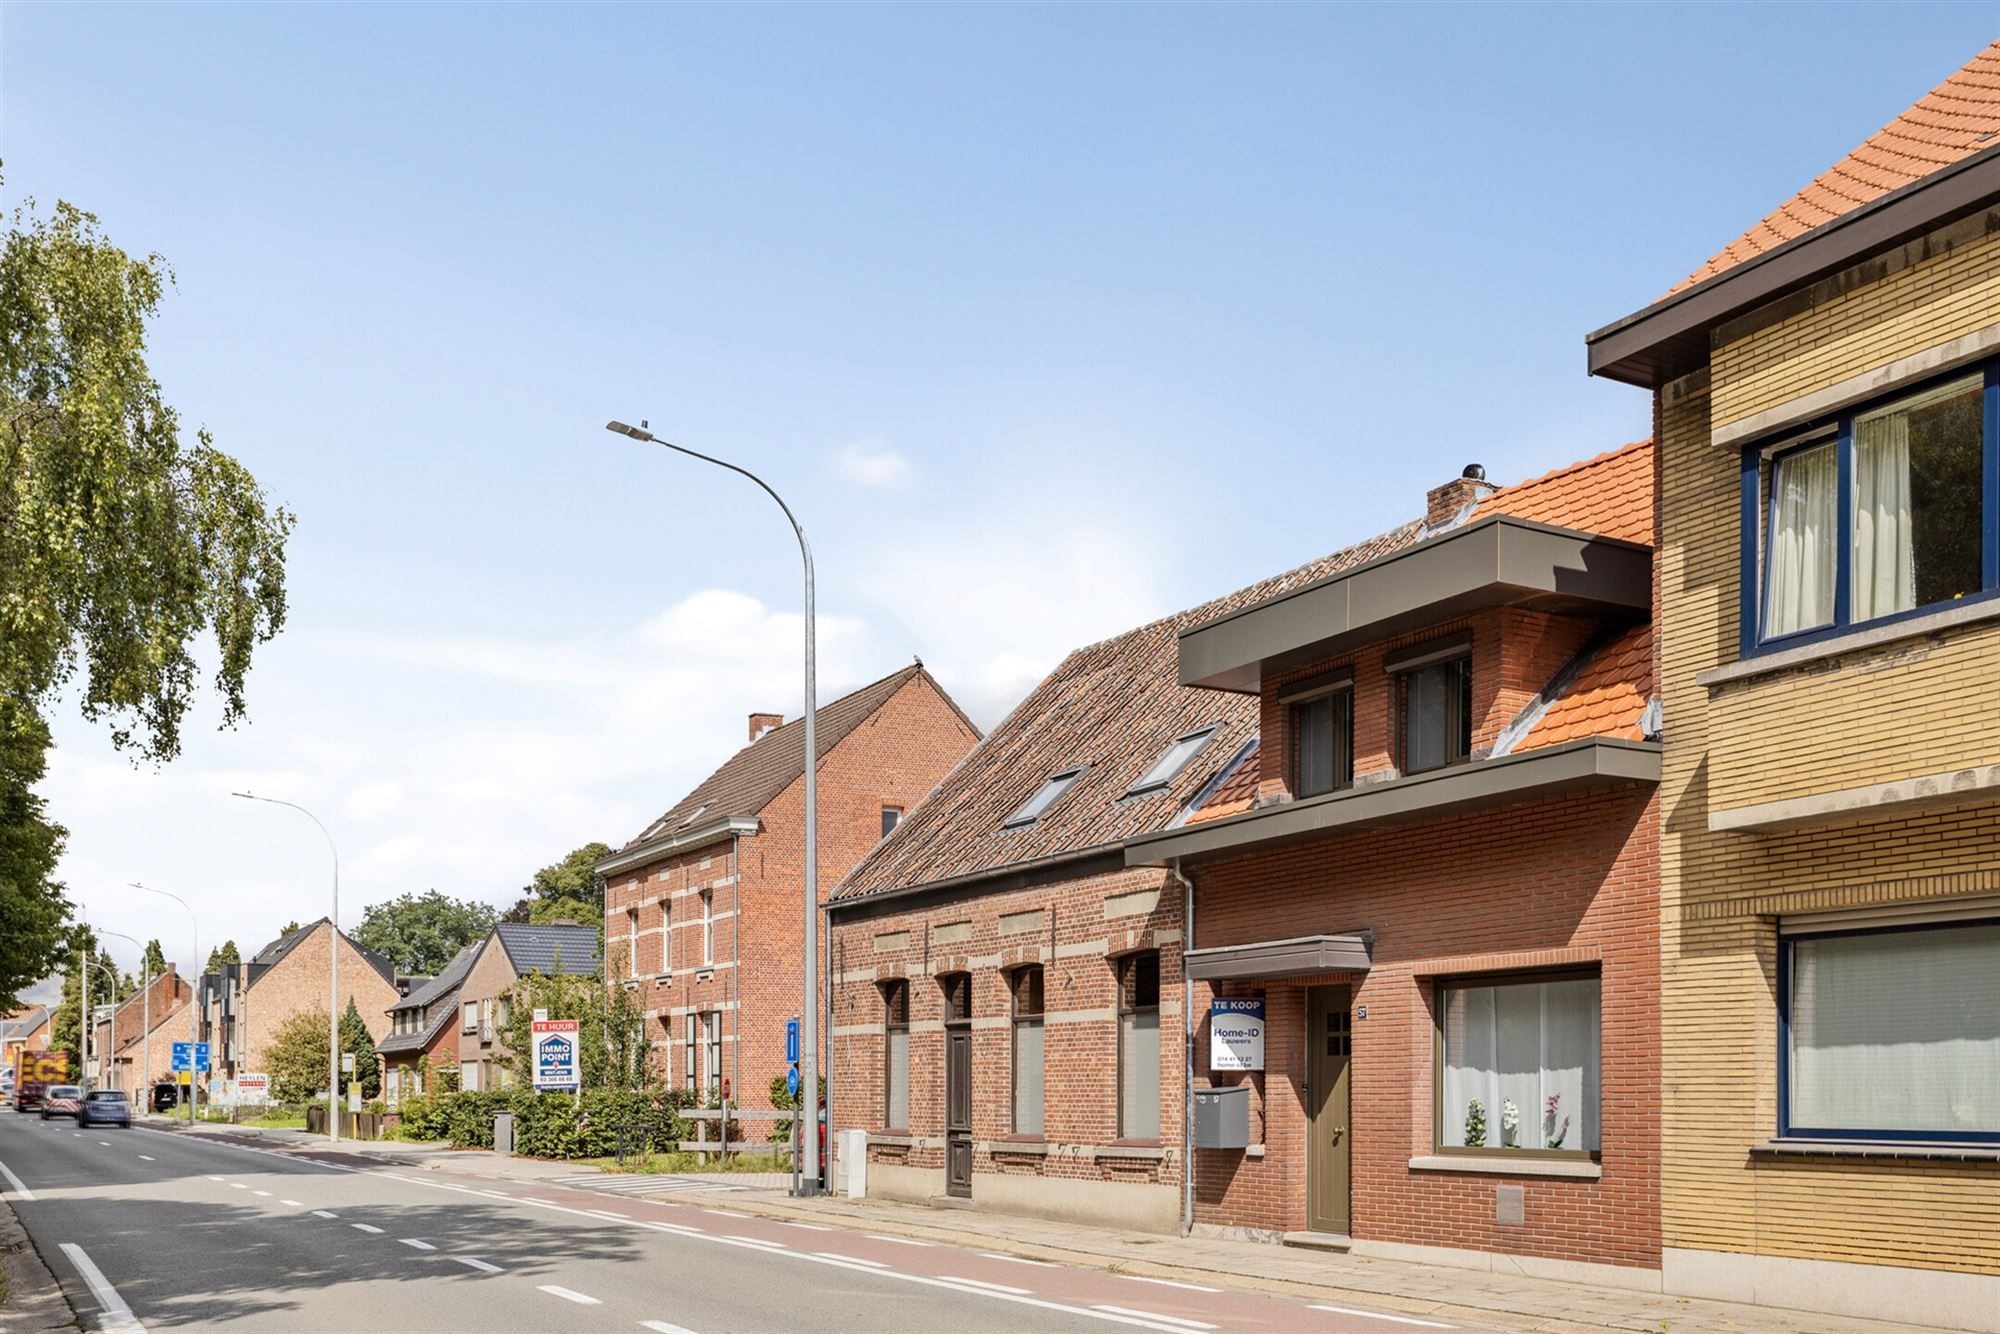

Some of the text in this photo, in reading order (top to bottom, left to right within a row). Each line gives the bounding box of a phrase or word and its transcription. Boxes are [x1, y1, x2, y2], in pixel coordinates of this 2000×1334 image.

[1214, 1001, 1261, 1009] TE KOOP
[536, 1023, 574, 1031] TE HUUR
[1214, 1028, 1259, 1037] Home-ID
[541, 1045, 570, 1053] IMMO
[541, 1053, 570, 1061] POINT
